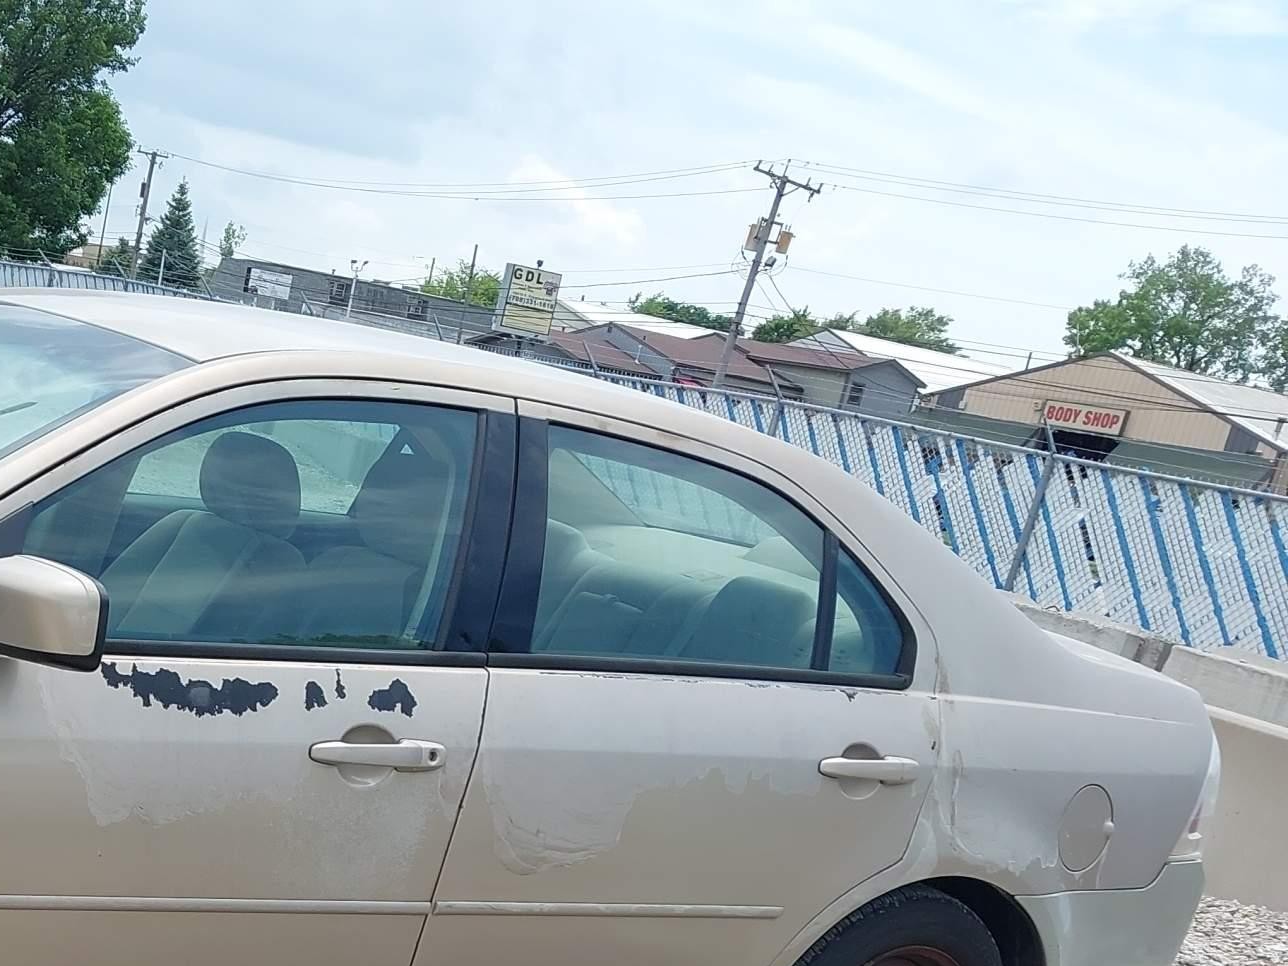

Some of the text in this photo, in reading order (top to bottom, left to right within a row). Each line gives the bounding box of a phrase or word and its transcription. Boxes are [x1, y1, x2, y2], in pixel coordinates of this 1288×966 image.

[514, 267, 544, 285] GDL
[1046, 405, 1120, 429] BODY SHOP
